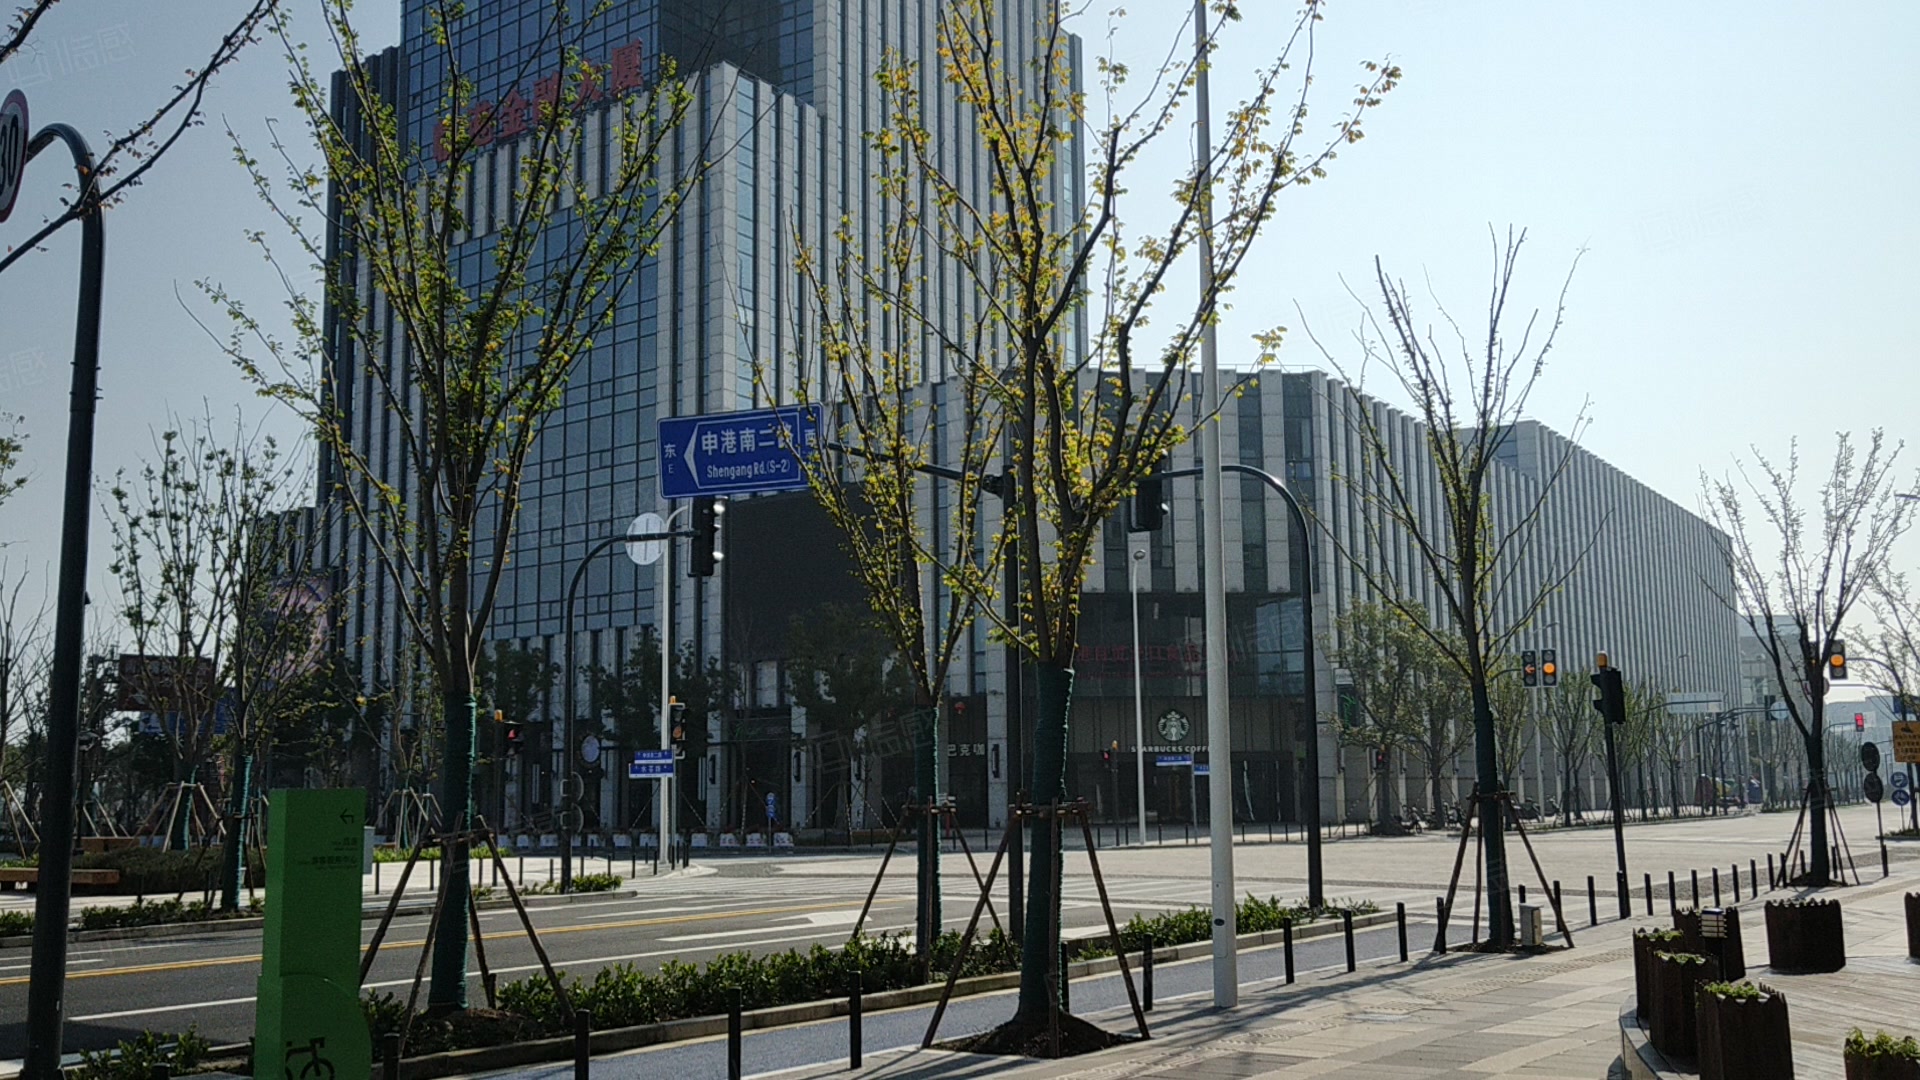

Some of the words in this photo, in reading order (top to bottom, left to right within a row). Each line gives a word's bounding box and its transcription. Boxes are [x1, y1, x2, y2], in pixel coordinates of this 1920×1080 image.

[0, 113, 19, 197] 30
[701, 423, 794, 455] 申港南二路
[664, 443, 677, 459] 东
[668, 464, 675, 475] E
[706, 463, 753, 480] Shengang
[1131, 745, 1183, 753] SARBUCKS
[1185, 745, 1210, 753] COFF
